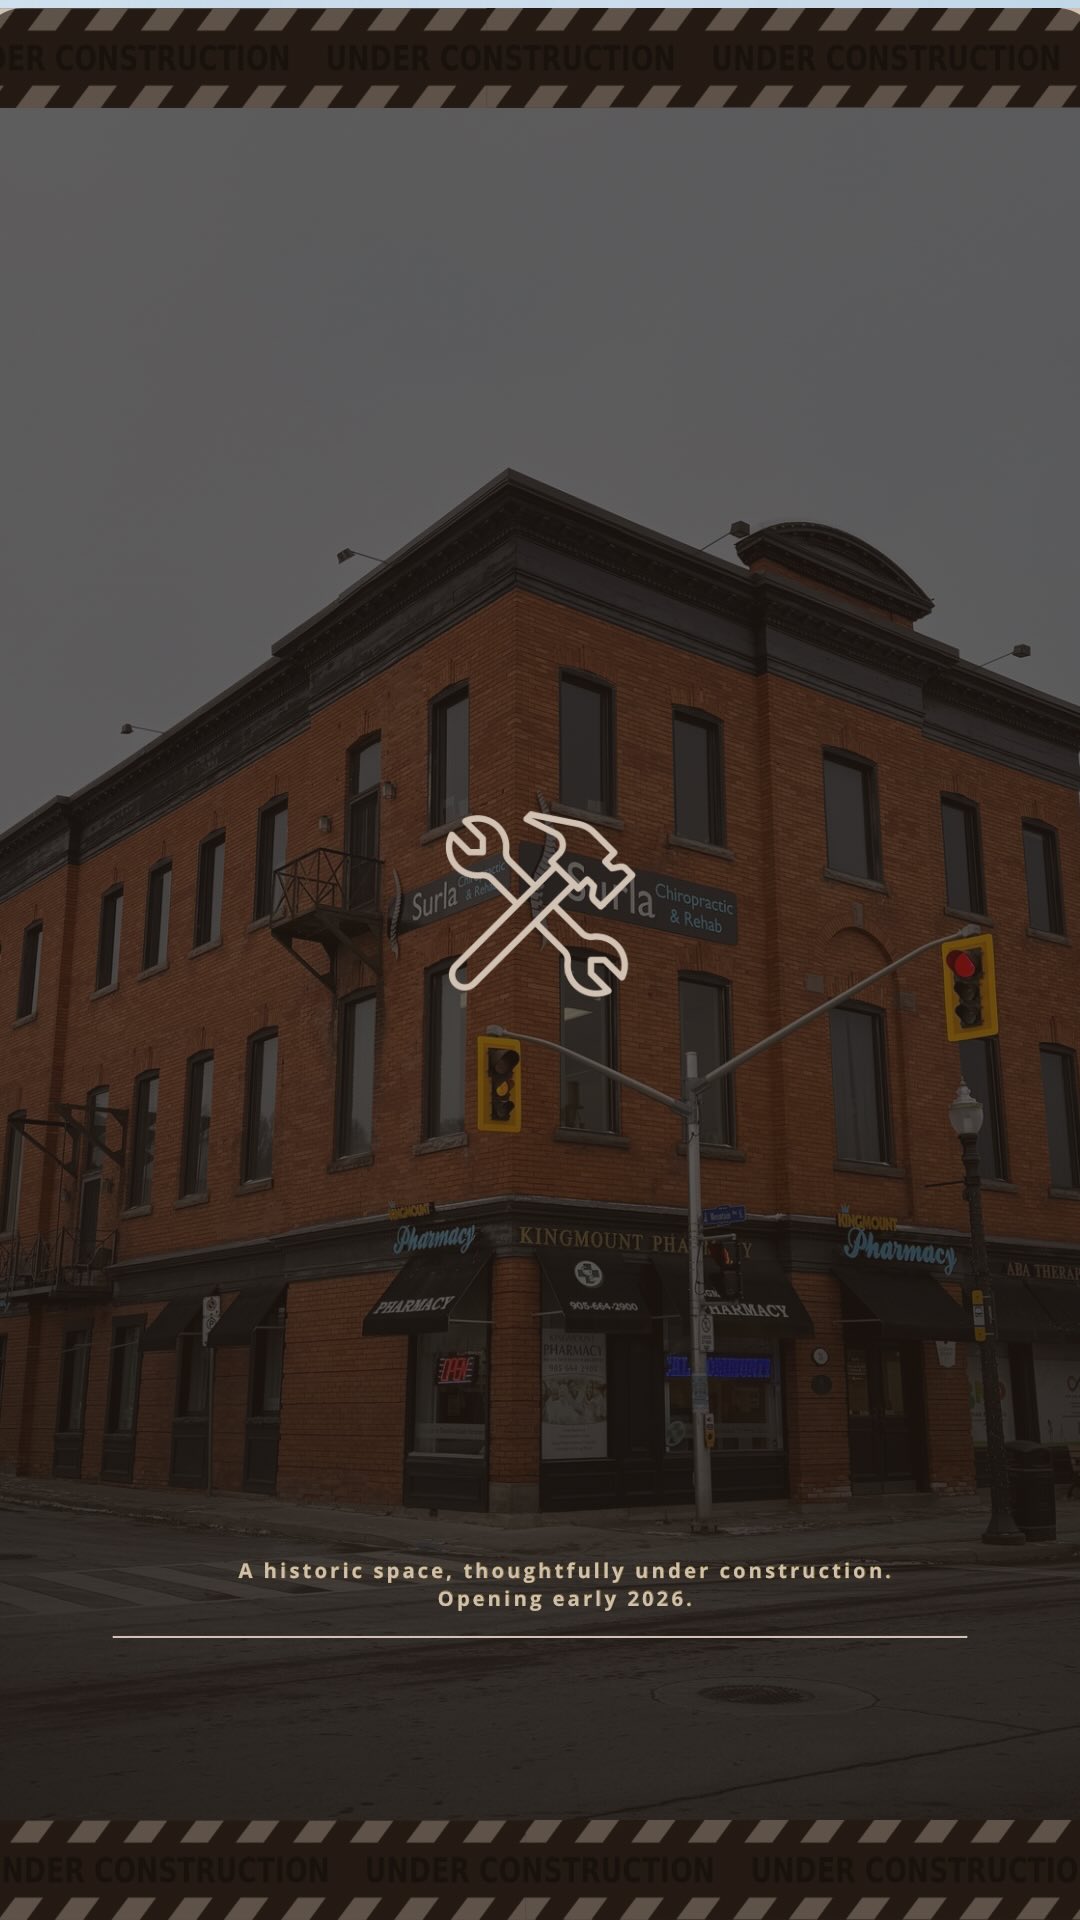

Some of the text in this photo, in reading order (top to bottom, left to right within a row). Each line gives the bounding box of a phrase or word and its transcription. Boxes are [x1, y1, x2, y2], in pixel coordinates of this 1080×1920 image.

[411, 881, 459, 921] Surla
[654, 883, 734, 916] Chiropractic
[670, 908, 723, 933] & Rehab
[837, 1214, 897, 1232] KINGMOUNT
[393, 1224, 476, 1255] Pharmacy
[519, 1226, 644, 1251] KINGMOUNT
[843, 1227, 957, 1276] Pharmacy
[1007, 1261, 1030, 1277] ABA
[373, 1296, 456, 1315] PHARMACY
[569, 1300, 639, 1313] 905-664-2900
[543, 1343, 603, 1356] PHARMACY
